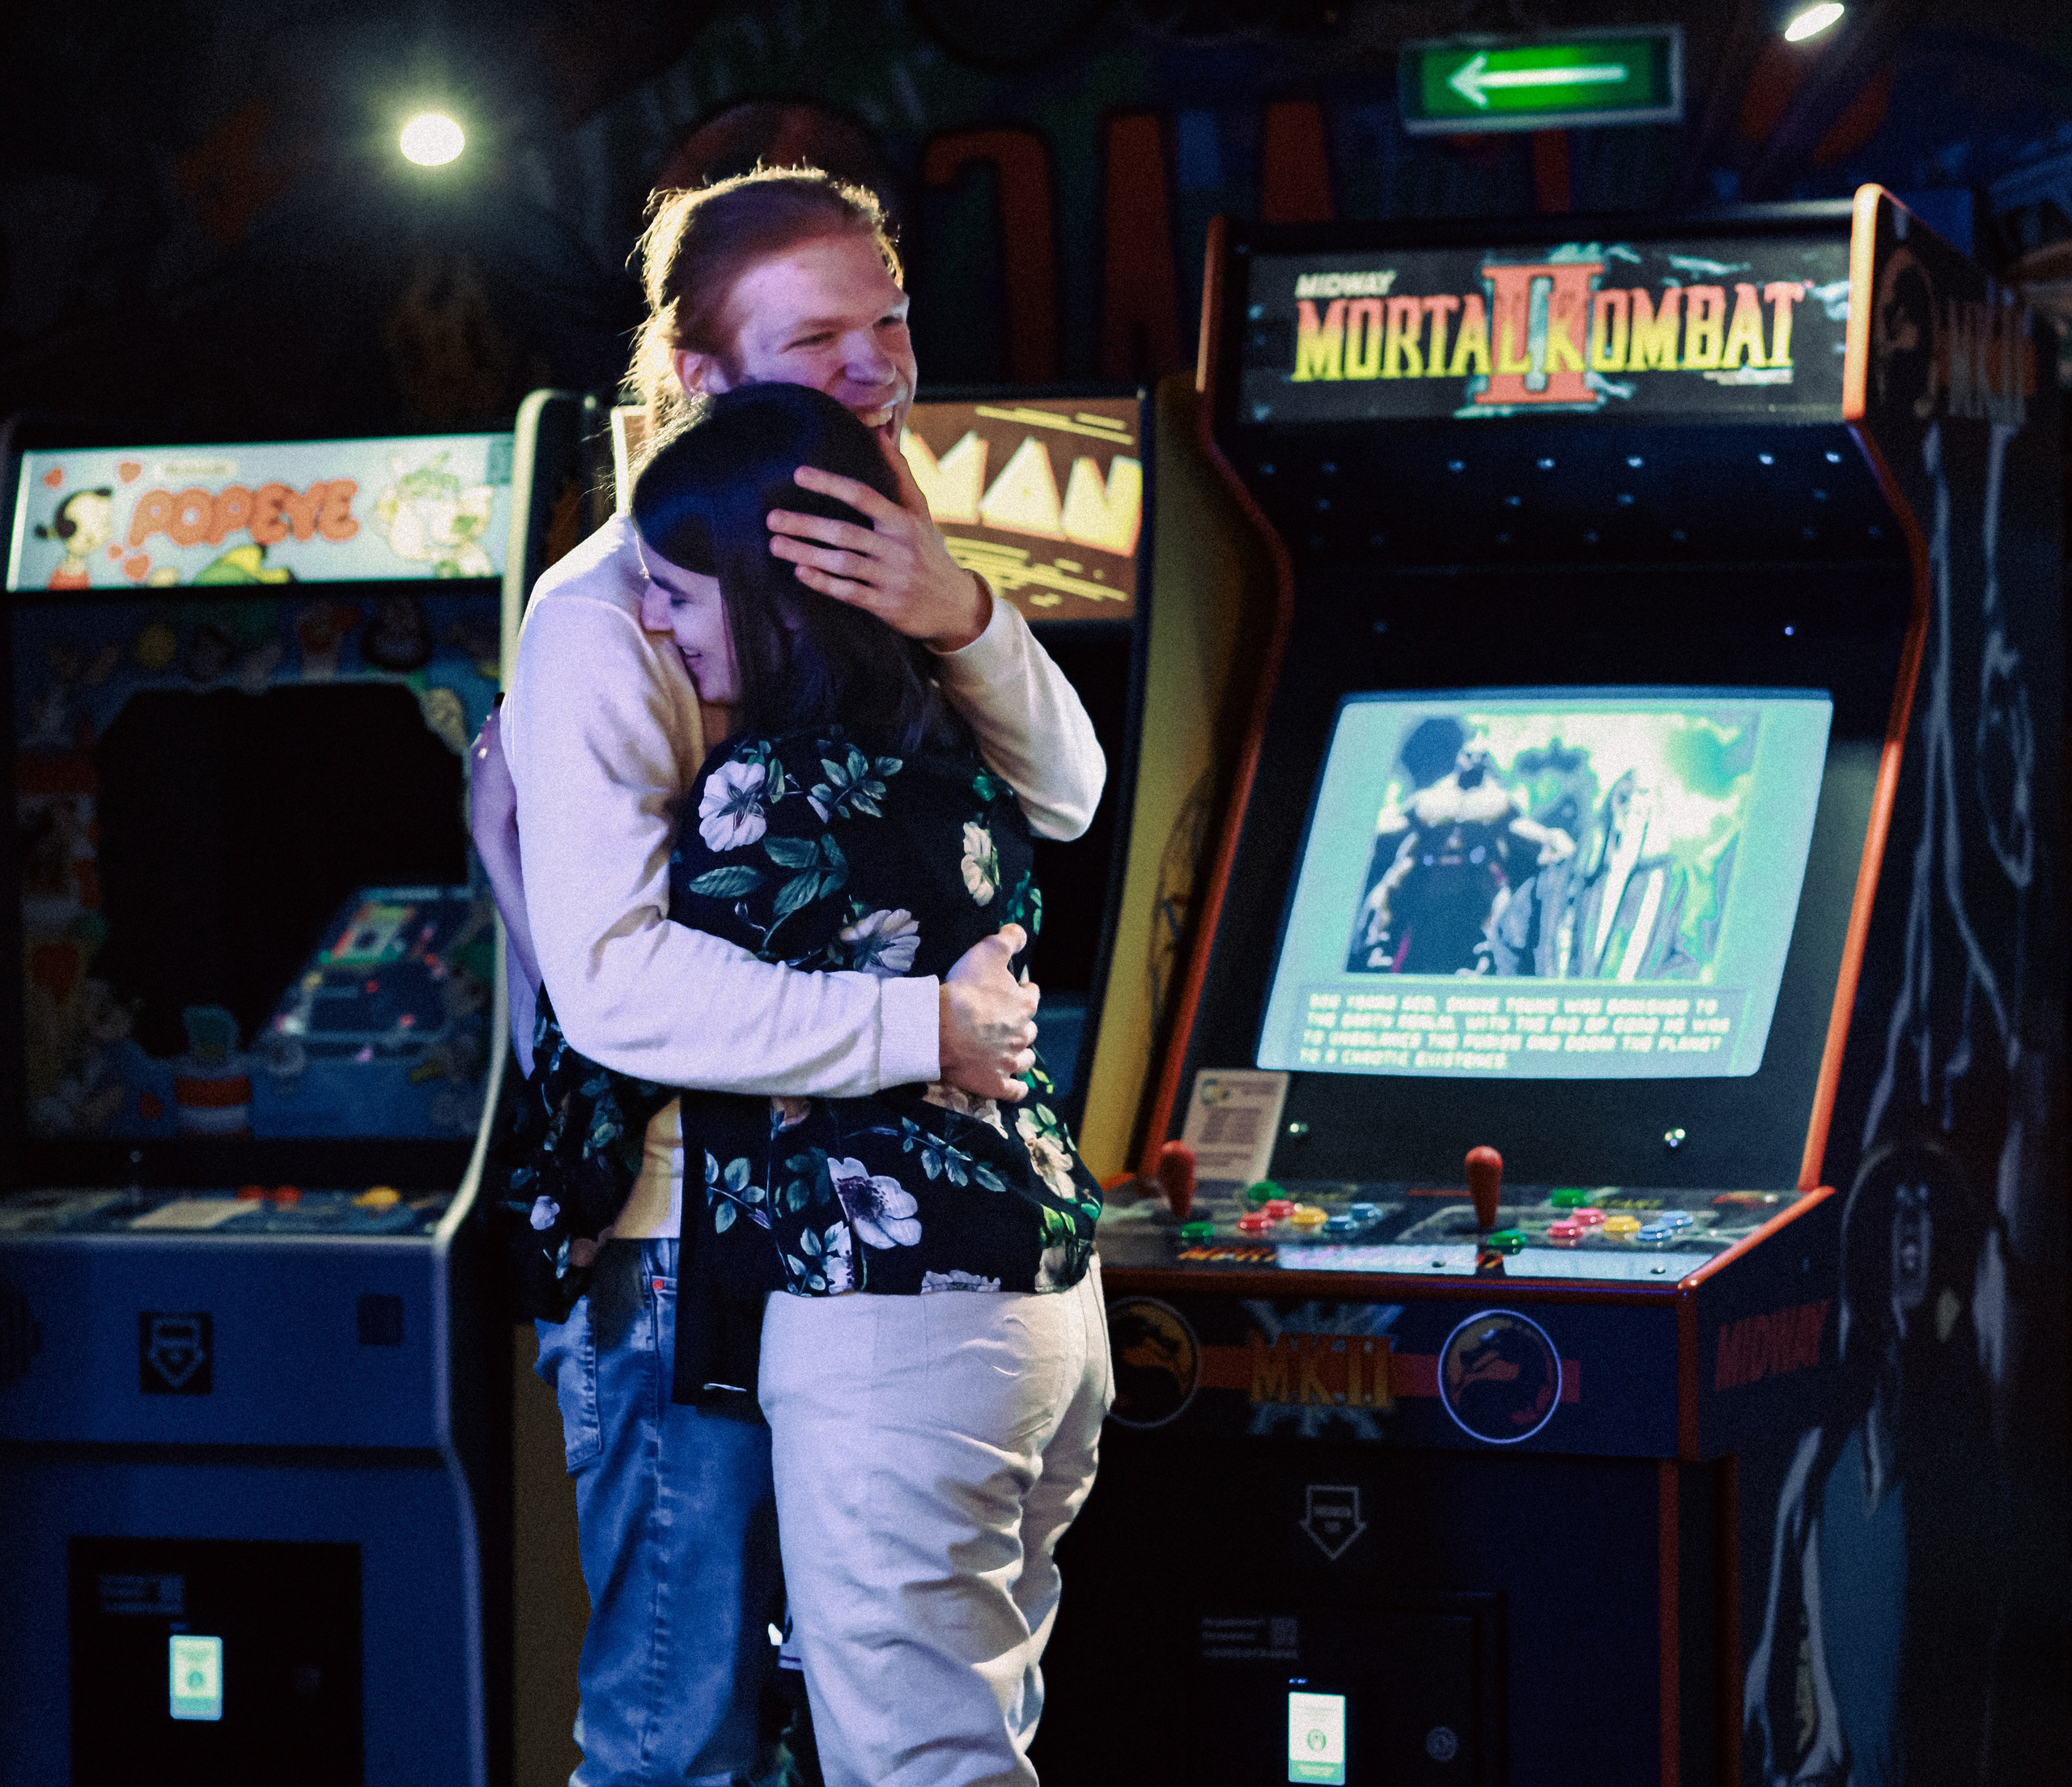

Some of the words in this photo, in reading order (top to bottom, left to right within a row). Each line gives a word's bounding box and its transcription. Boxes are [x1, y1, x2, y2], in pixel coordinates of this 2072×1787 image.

[1295, 270, 1398, 299] MIDWAY
[1291, 293, 1531, 382] MORTAL
[1543, 282, 1805, 373] KOMBAT
[126, 478, 359, 548] POPEYE
